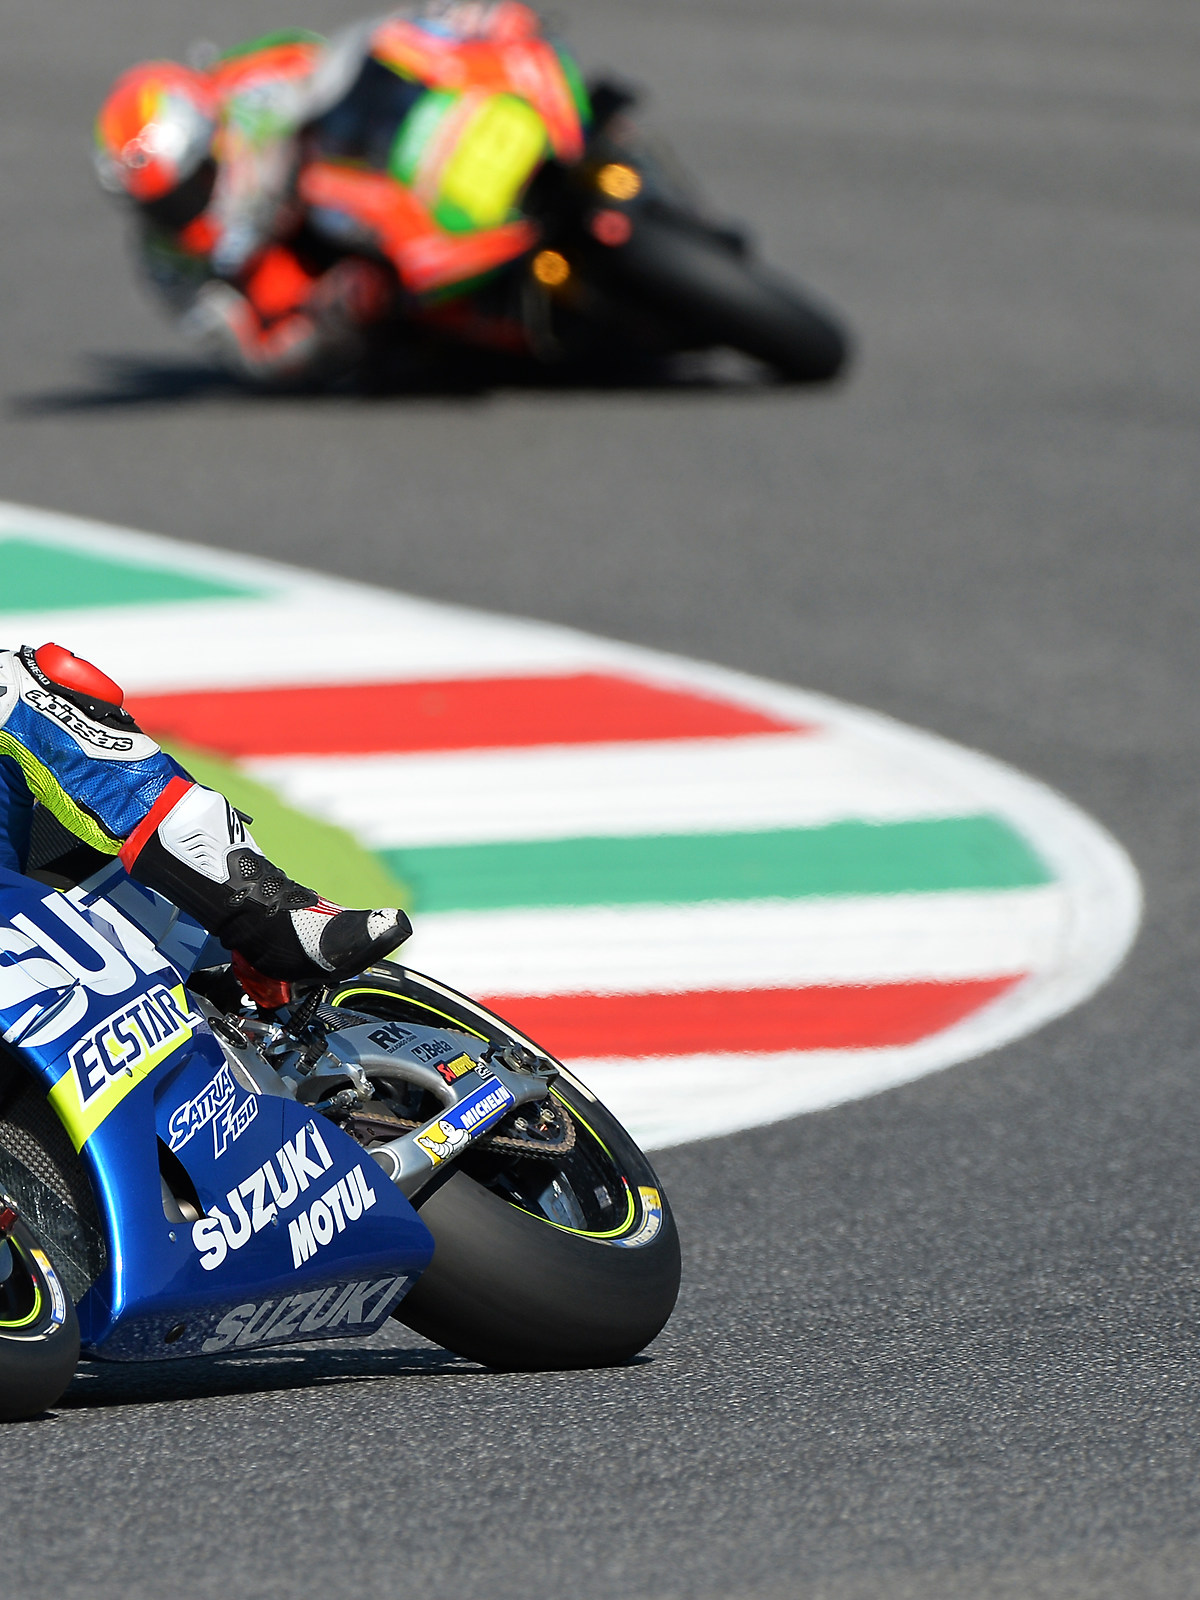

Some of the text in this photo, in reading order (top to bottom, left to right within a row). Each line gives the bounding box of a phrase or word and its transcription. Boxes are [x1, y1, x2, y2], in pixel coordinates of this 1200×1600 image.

[25, 690, 133, 752] alpinestars
[70, 985, 203, 1106] ECSTAR
[367, 1021, 412, 1051] RK
[425, 1039, 453, 1060] Beta
[169, 1060, 235, 1153] SATRIA
[460, 1085, 511, 1129] MICHELIN
[192, 1119, 334, 1271] SUZUKI
[288, 1164, 377, 1269] MOTUL
[202, 1276, 409, 1351] SUZUKI
